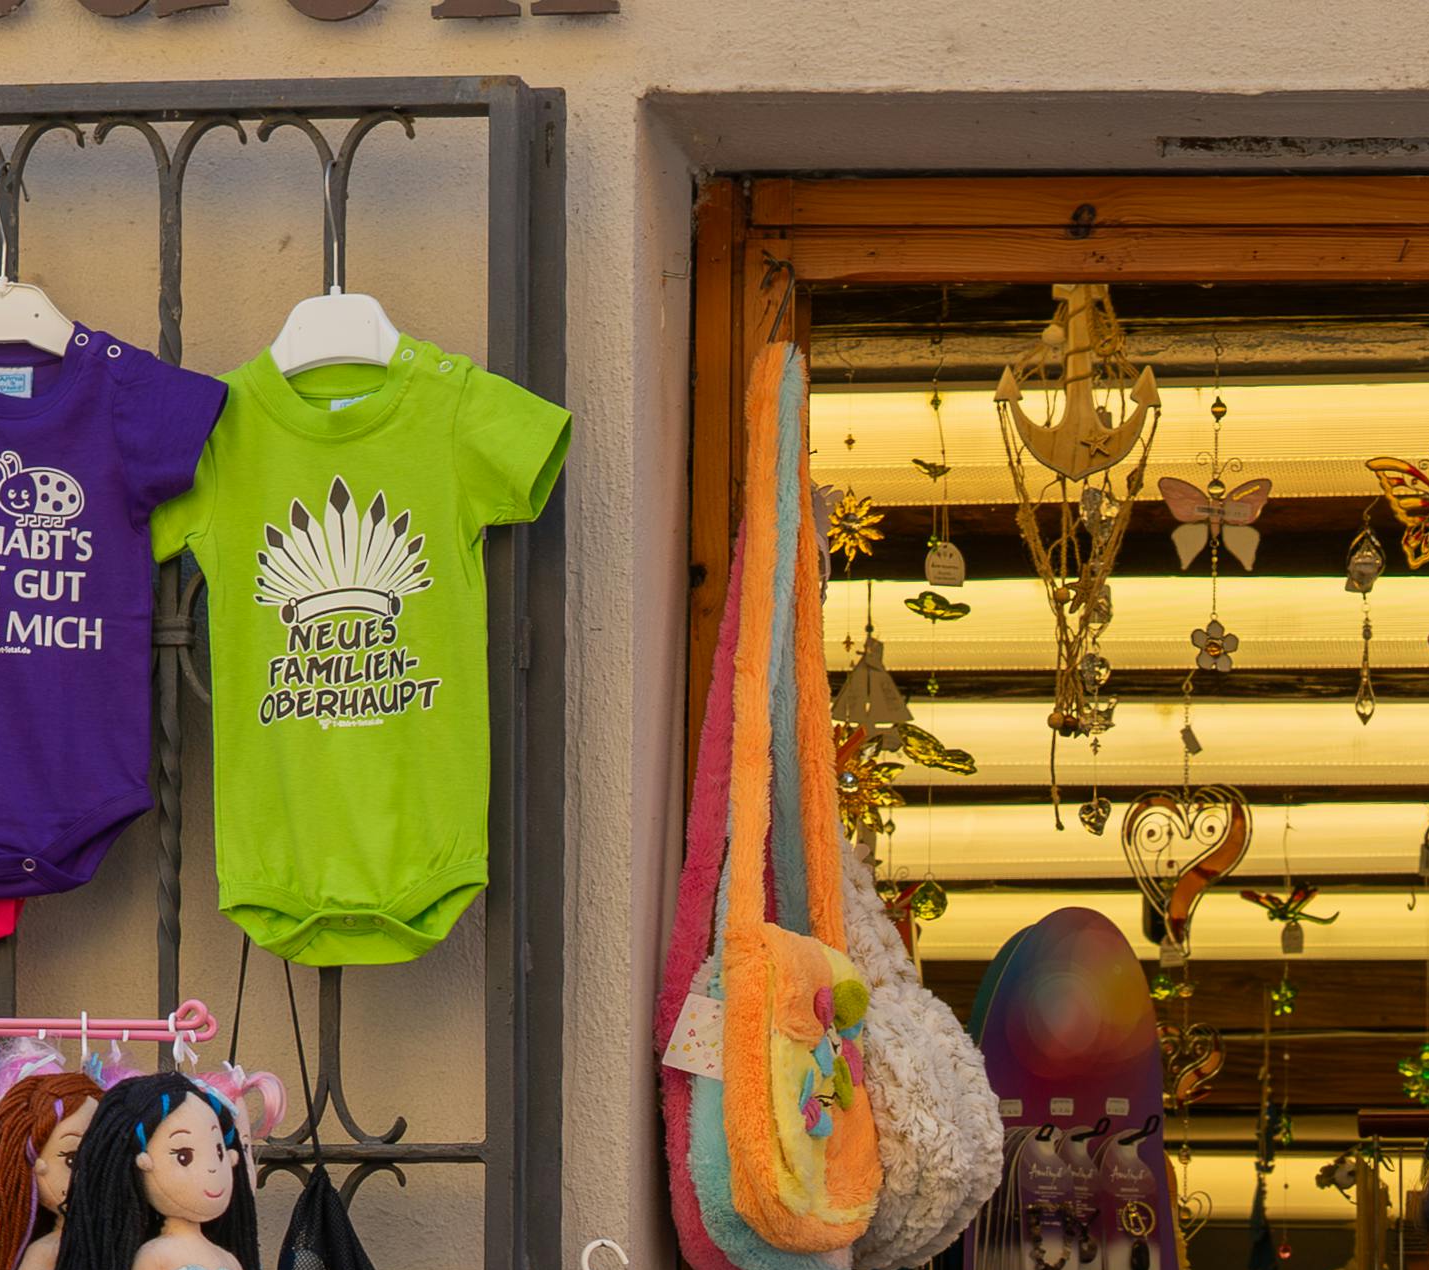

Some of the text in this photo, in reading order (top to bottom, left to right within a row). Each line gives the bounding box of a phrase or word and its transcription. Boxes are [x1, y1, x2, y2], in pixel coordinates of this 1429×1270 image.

[13, 566, 87, 603] GUT
[5, 610, 104, 651] MICH
[287, 614, 399, 655] NEUES
[267, 648, 418, 688] FAMILIEN-
[259, 679, 442, 726] OBERHAUPT
